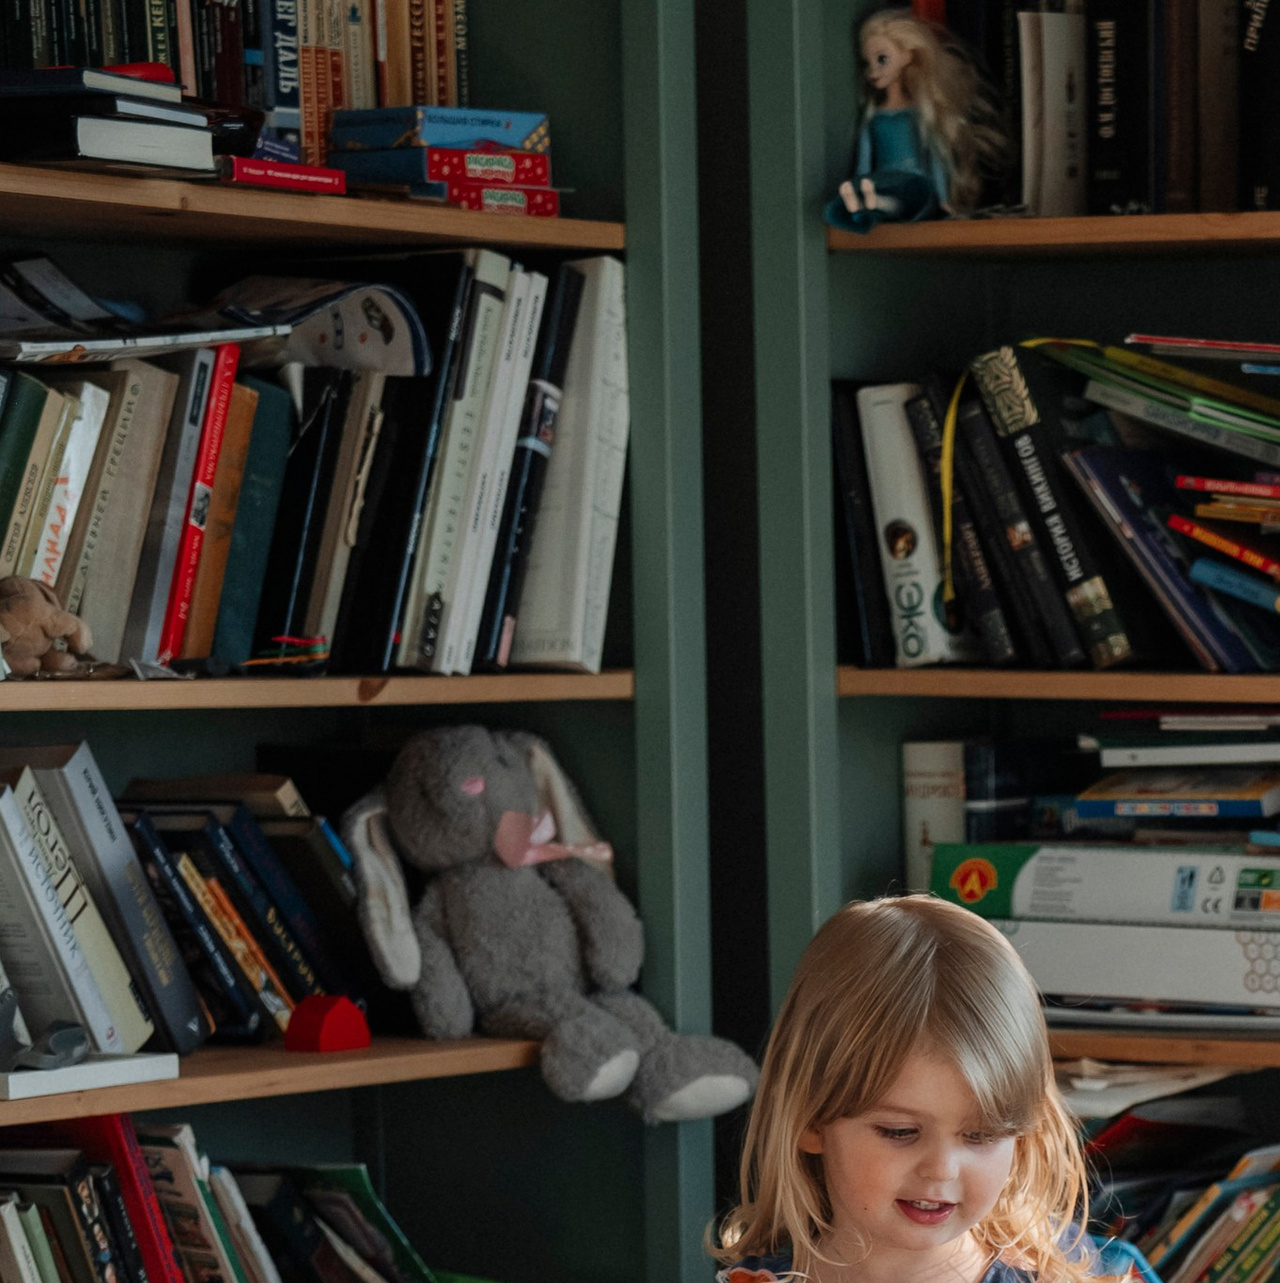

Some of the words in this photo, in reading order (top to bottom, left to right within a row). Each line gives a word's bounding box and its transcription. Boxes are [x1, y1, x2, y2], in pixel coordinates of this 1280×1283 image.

[274, 31, 299, 93] ДАЛЬ
[107, 398, 136, 477] ГРЕЦИИ
[1013, 433, 1057, 512] ВИКИНГОВ
[1045, 513, 1083, 582] ИСТОРИЯ
[901, 583, 926, 659] ЭКО
[27, 848, 81, 958] ИСТОЧНИК
